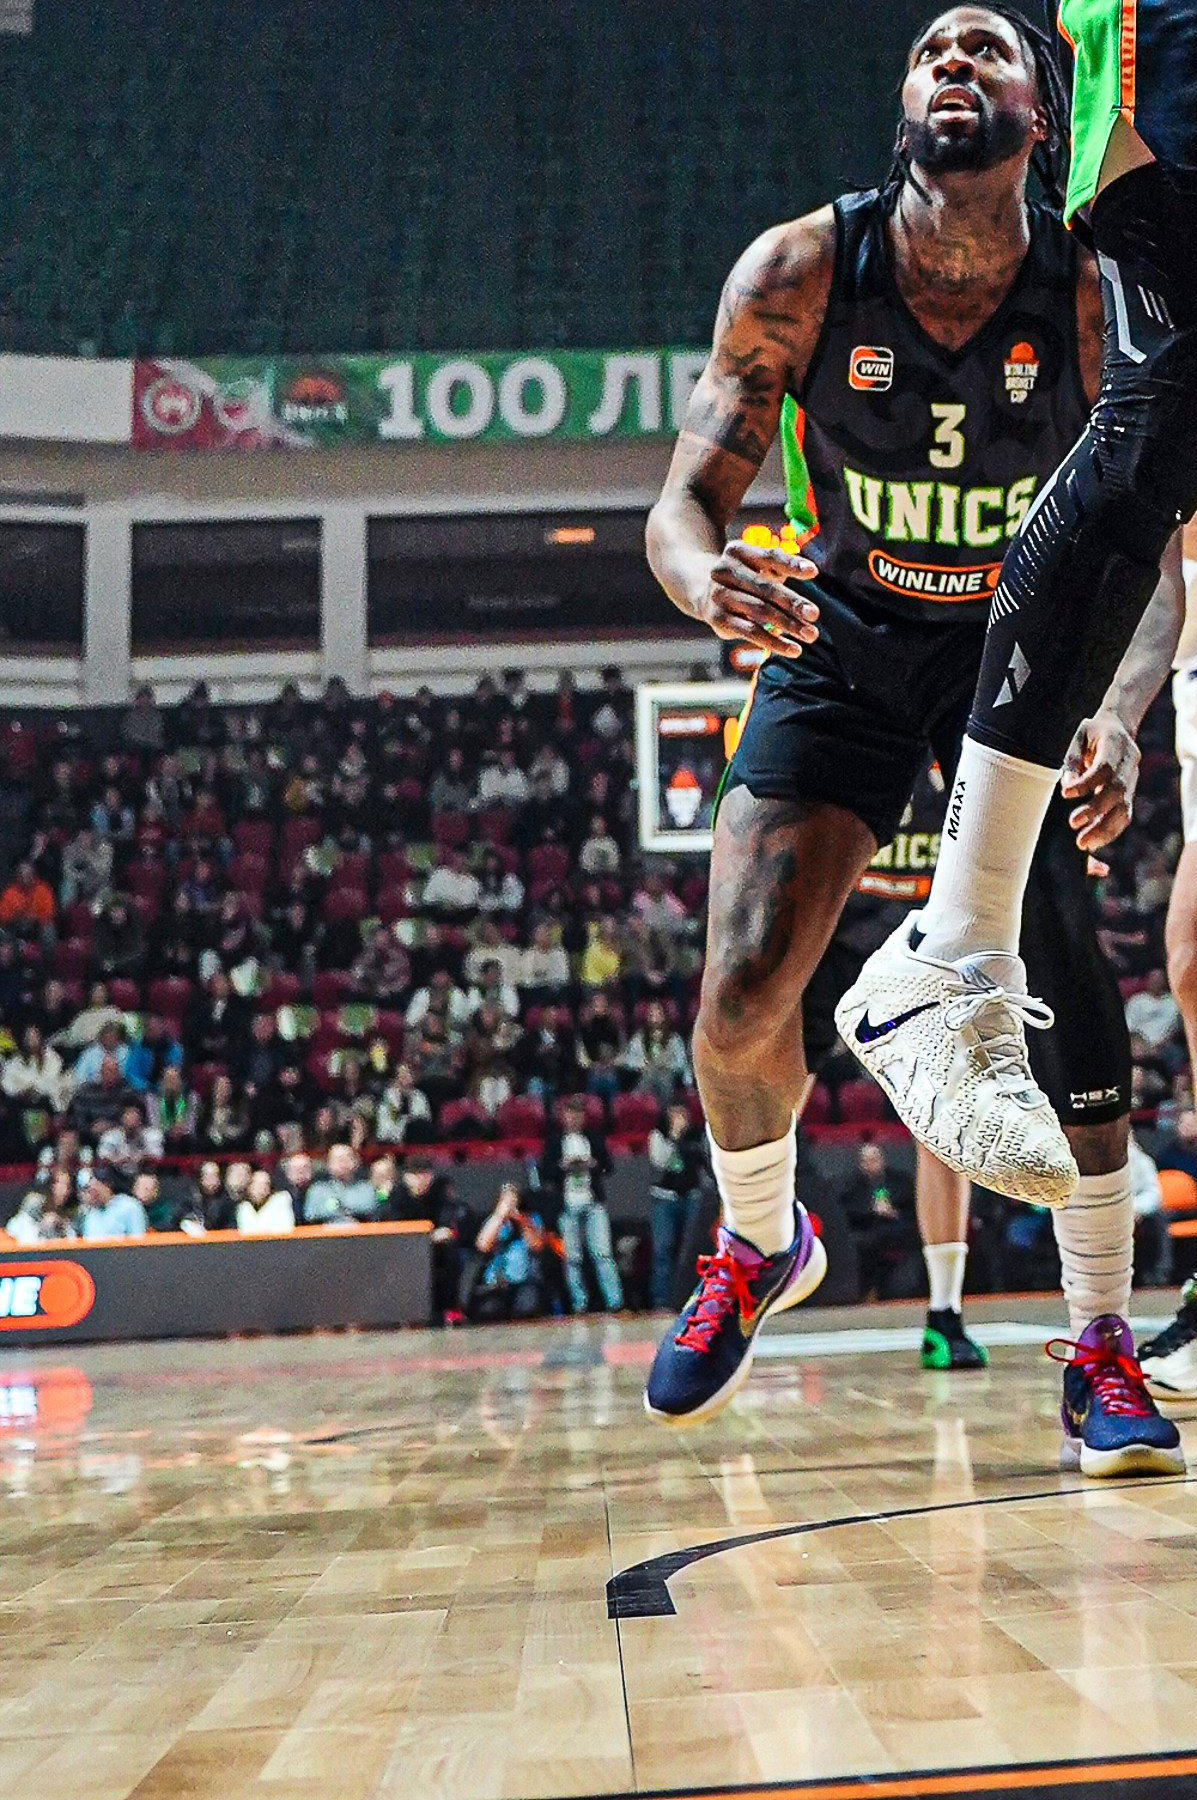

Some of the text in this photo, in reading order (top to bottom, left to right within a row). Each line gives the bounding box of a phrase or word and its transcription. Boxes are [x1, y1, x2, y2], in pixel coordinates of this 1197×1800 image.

[377, 357, 567, 440] 100
[859, 362, 891, 376] WIN
[929, 403, 966, 469] 3
[843, 464, 1037, 548] UNICS
[877, 558, 983, 594] WINLINE
